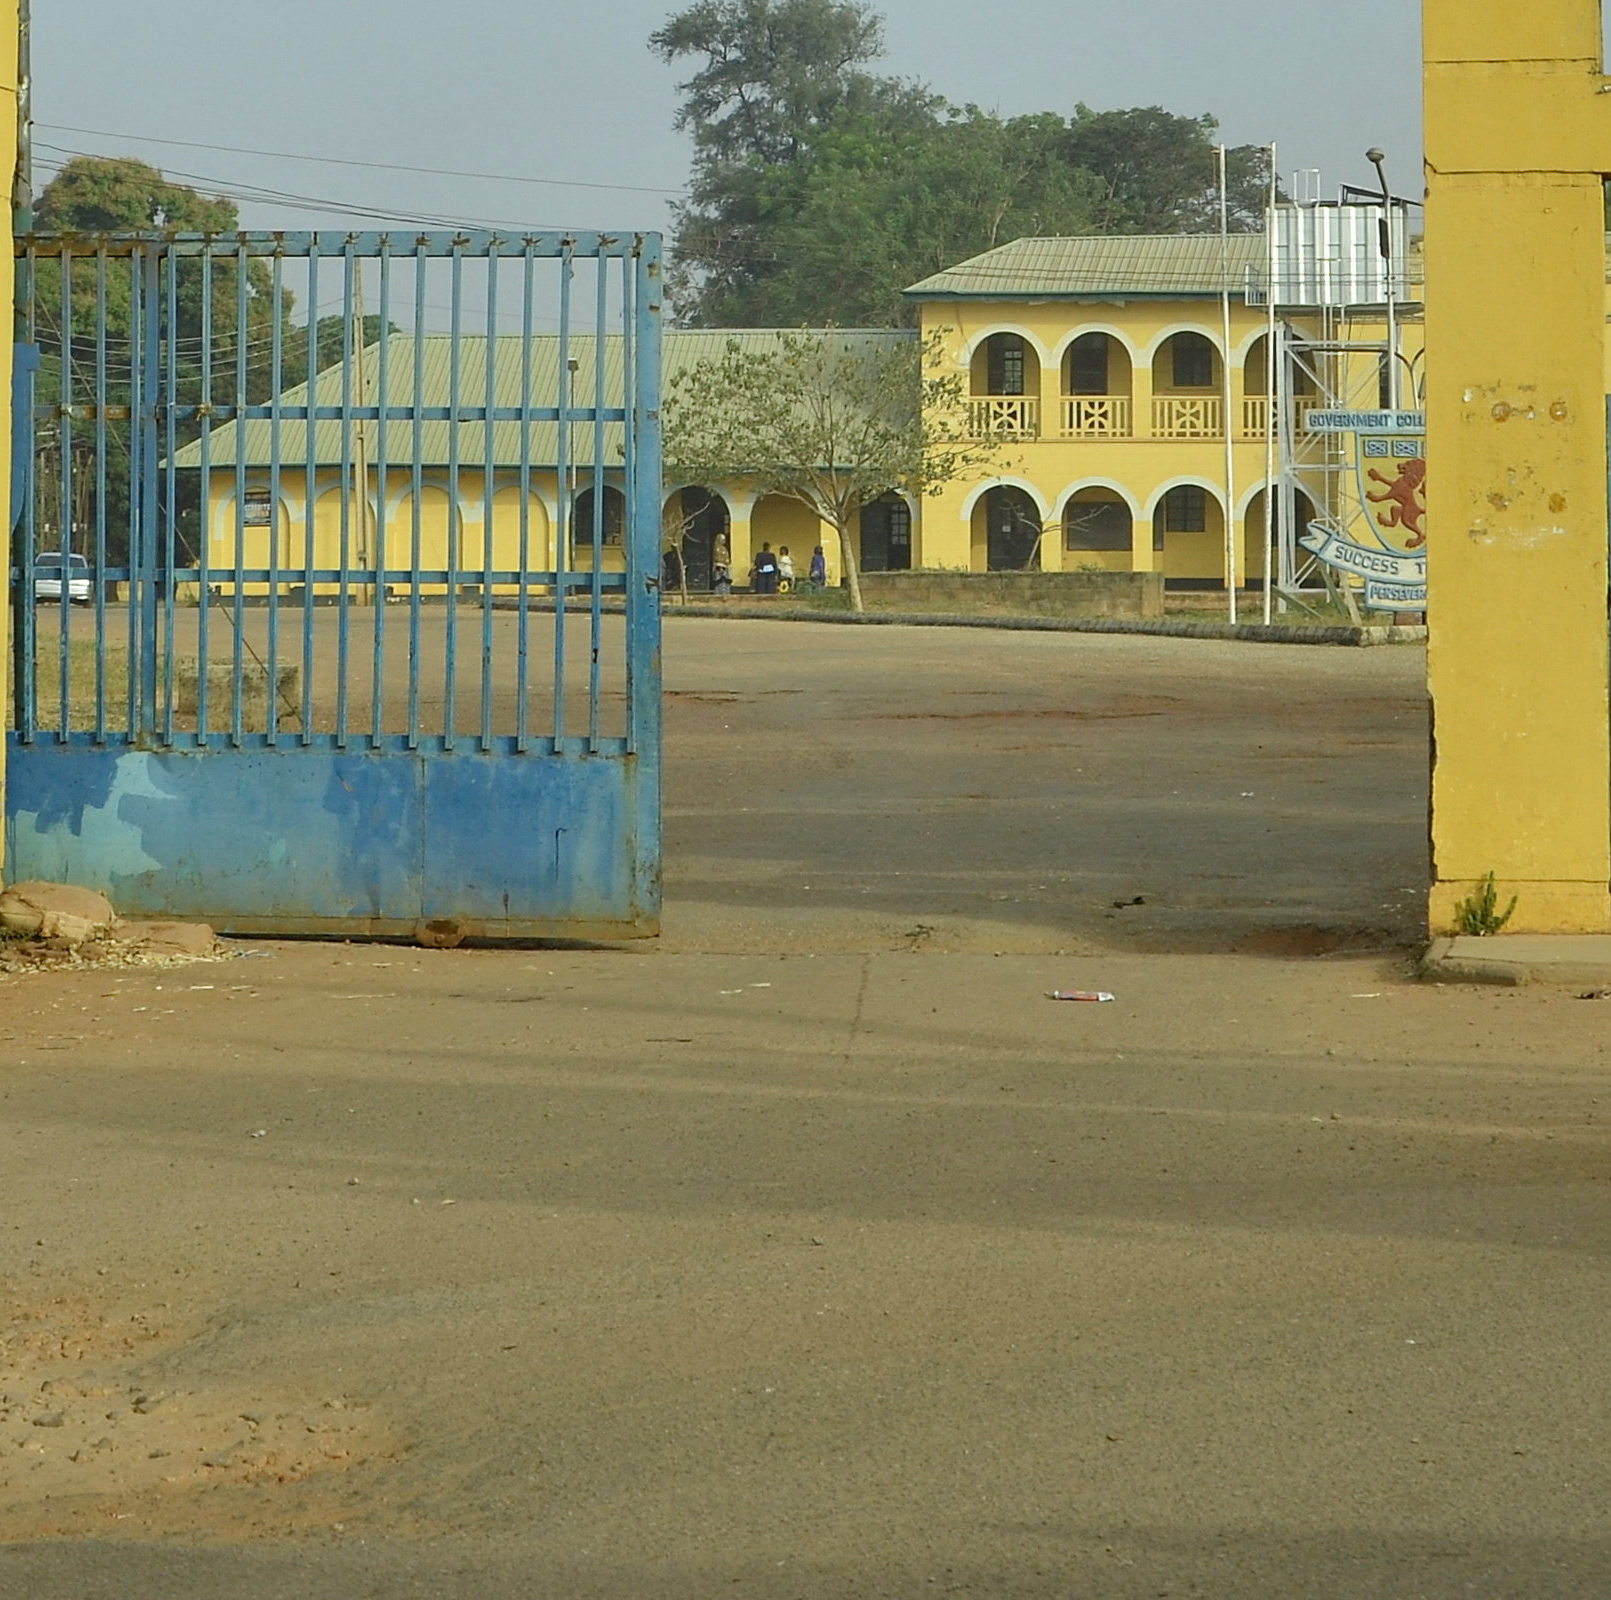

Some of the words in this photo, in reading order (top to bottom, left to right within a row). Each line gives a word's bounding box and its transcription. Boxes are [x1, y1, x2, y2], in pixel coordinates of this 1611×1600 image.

[1308, 413, 1392, 428] GOVERNMENT
[1395, 413, 1425, 428] COLL
[1334, 545, 1399, 576] SUCCESS
[1370, 584, 1426, 601] PERSEVER
